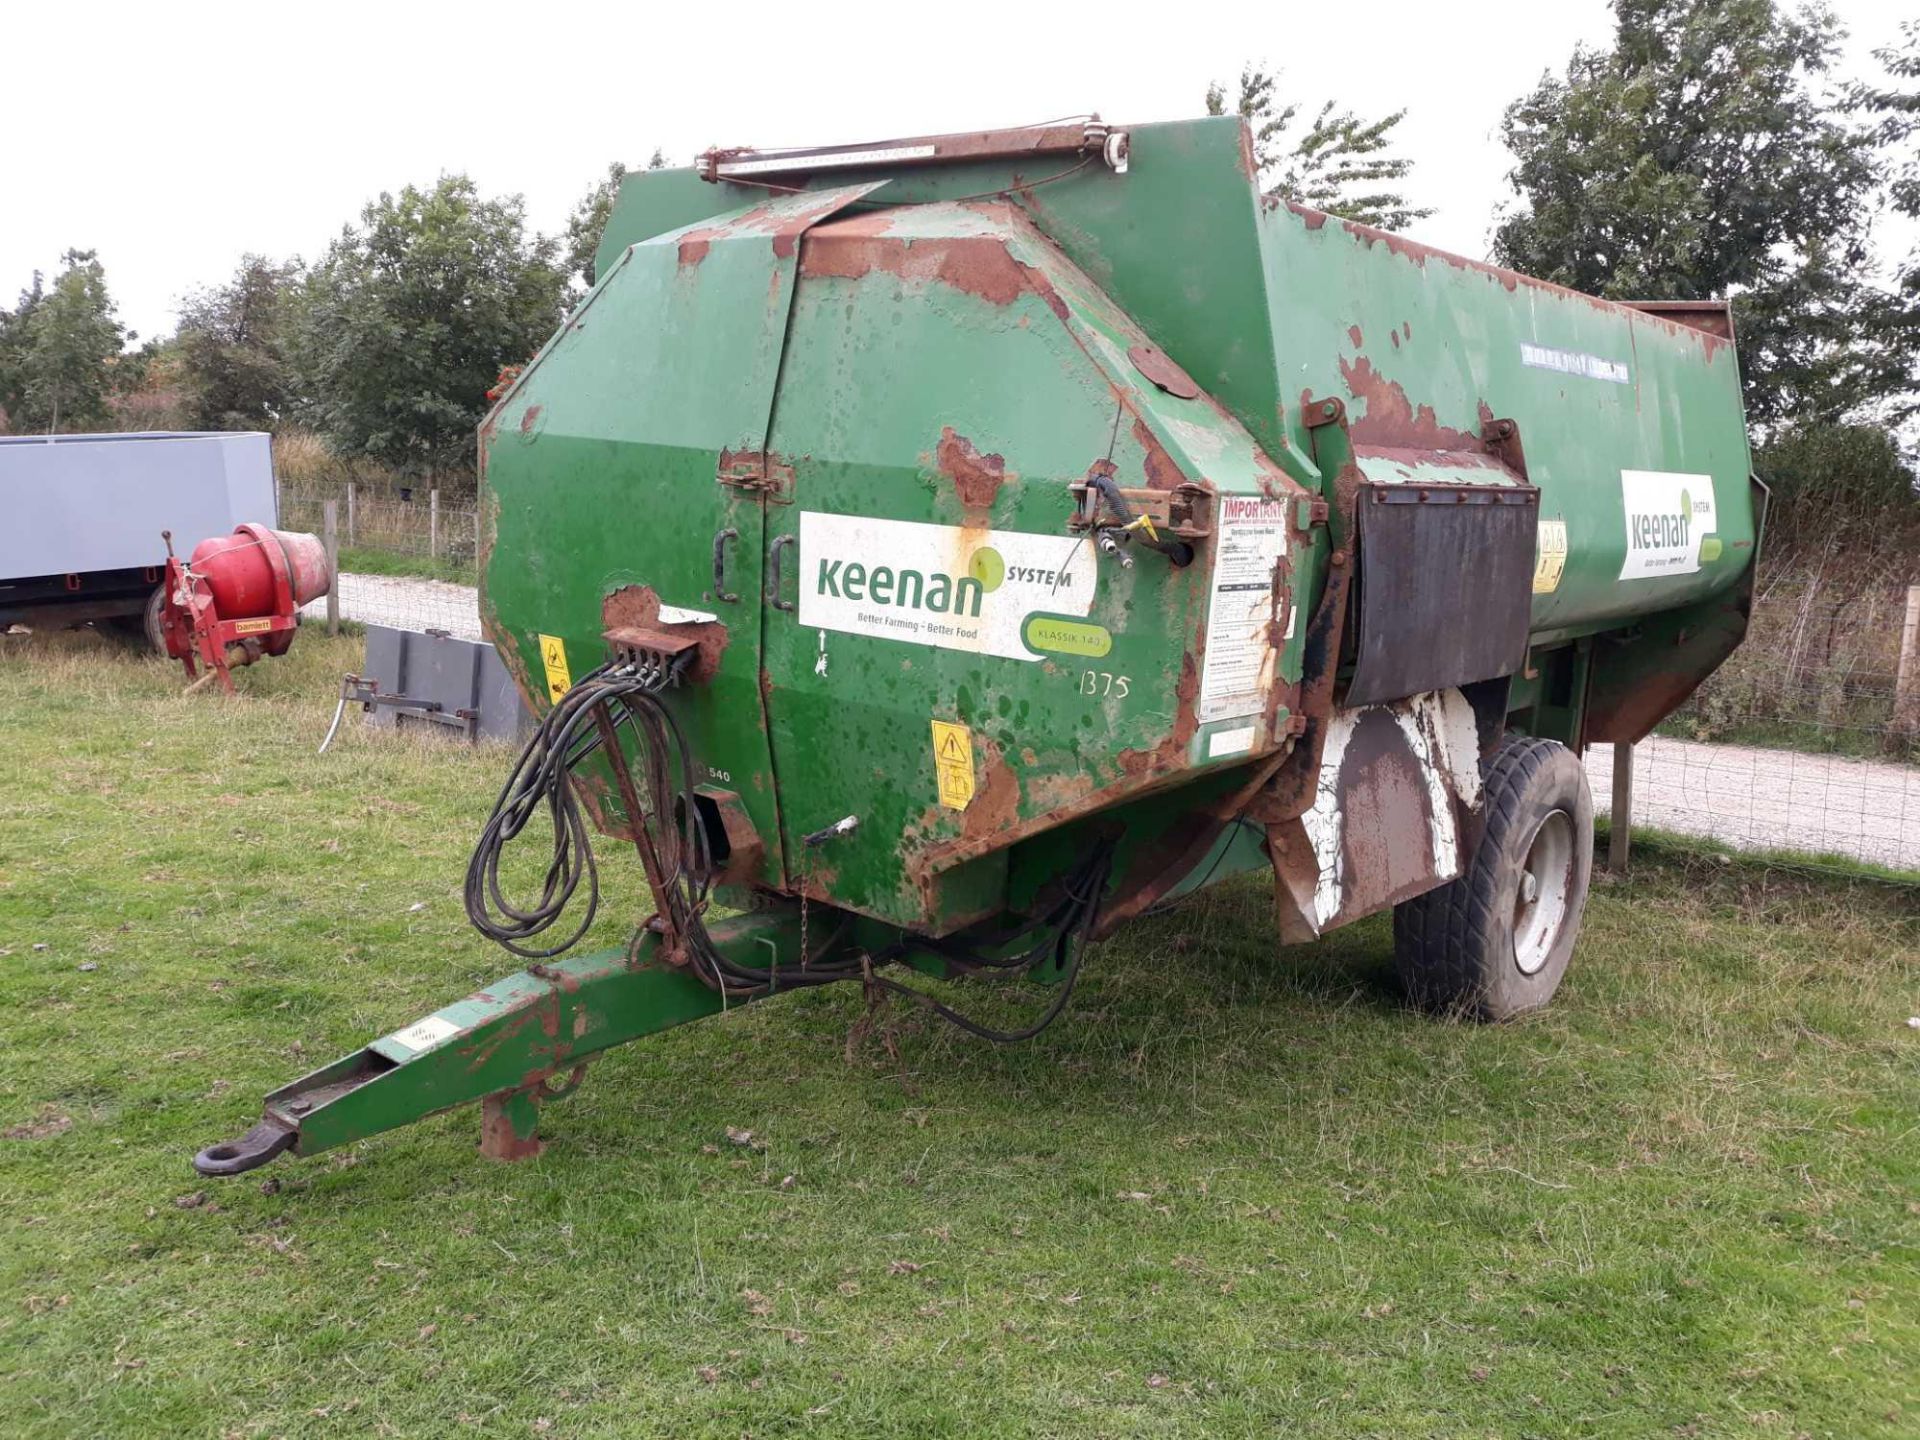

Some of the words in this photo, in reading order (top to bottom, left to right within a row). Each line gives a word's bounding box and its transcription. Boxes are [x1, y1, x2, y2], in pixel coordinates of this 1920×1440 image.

[1224, 500, 1281, 518] IMPORTANT
[1007, 566, 1072, 587] SYSTEM
[857, 612, 883, 625] Better
[885, 616, 919, 632] Farming
[927, 622, 954, 635] Better
[956, 627, 978, 639] Food
[1038, 629, 1078, 643] KLASSIK
[1080, 669, 1132, 698] 1375
[709, 768, 730, 781] 540
